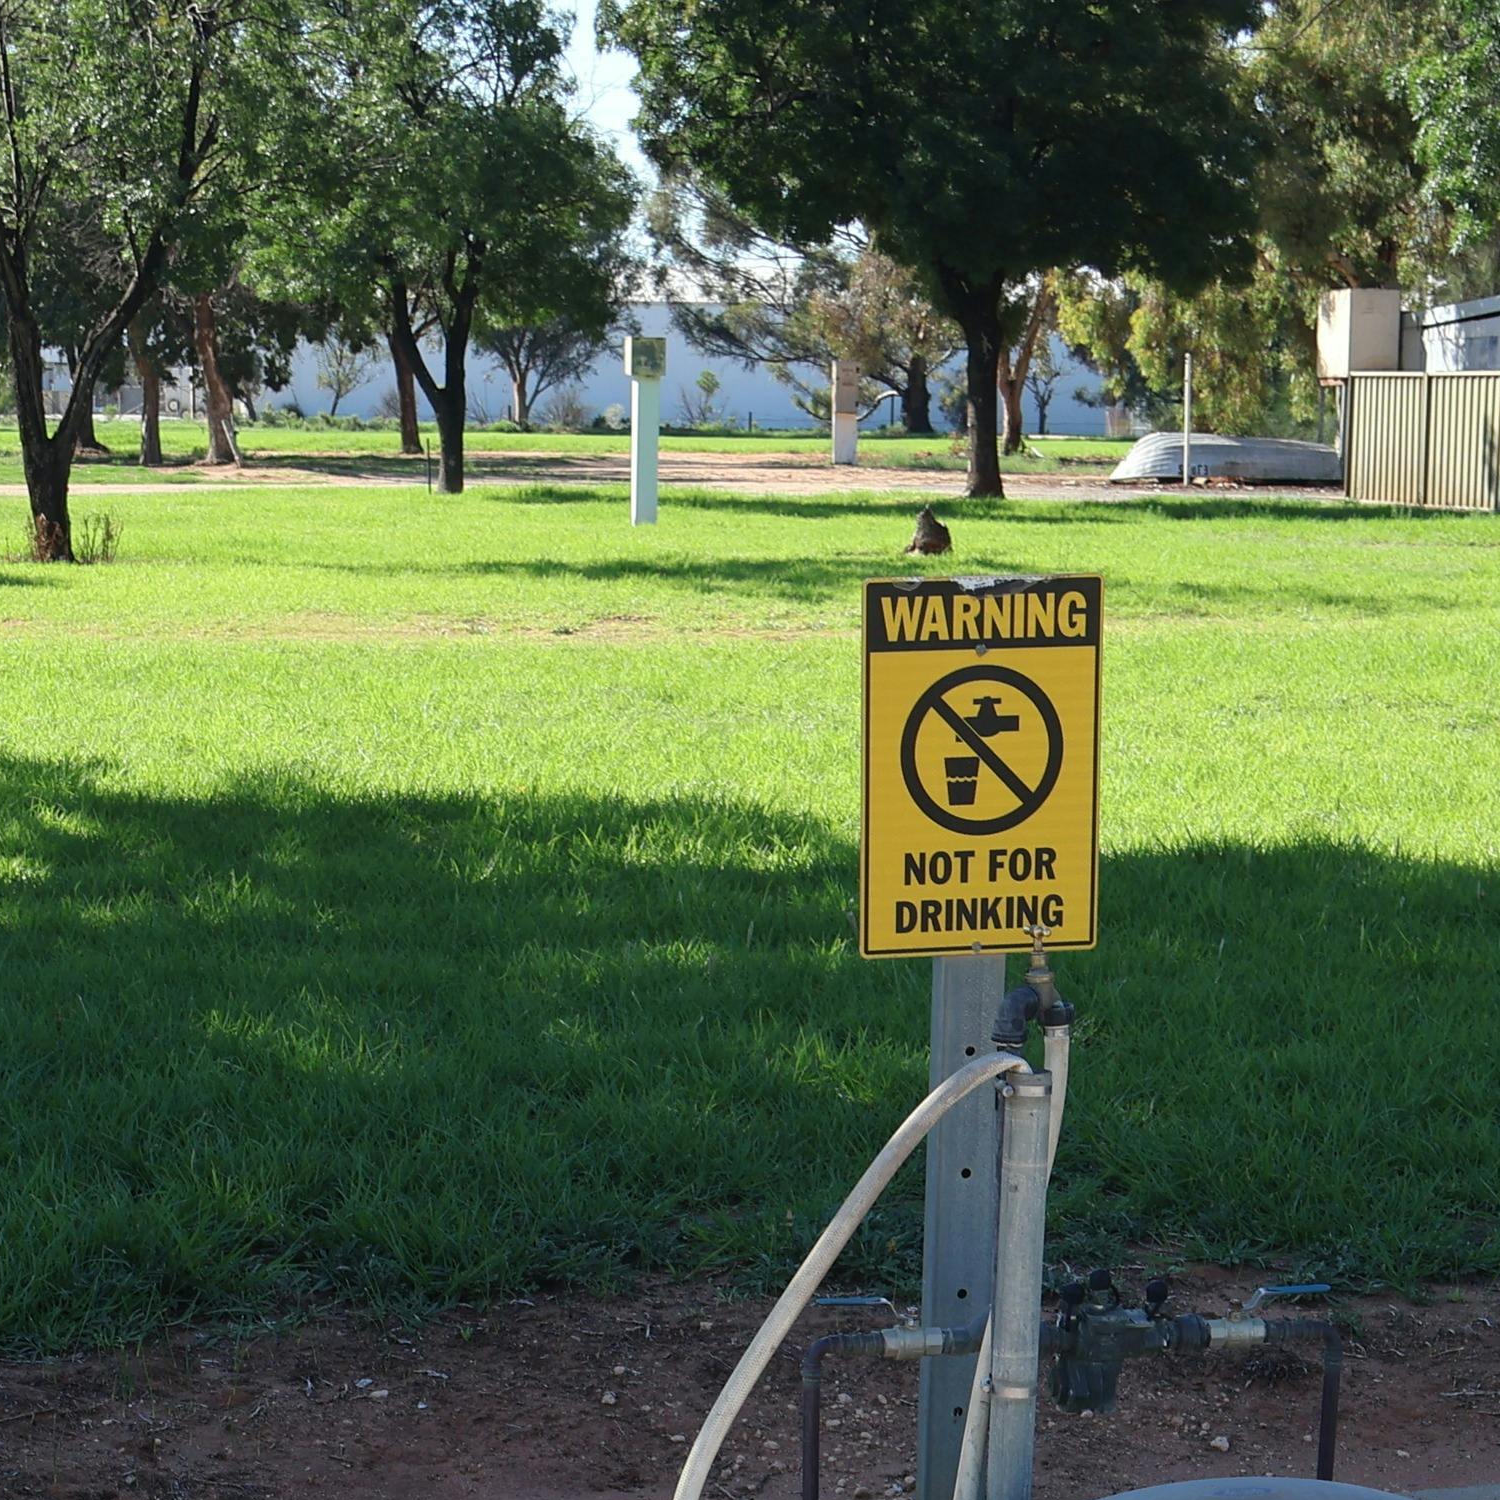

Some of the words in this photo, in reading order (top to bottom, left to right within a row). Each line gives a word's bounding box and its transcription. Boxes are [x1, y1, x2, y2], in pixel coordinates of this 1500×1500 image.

[880, 591, 1087, 643] WARNING
[903, 851, 975, 886] NOT
[988, 847, 1057, 882] FOR
[895, 894, 1064, 934] DRINKING
